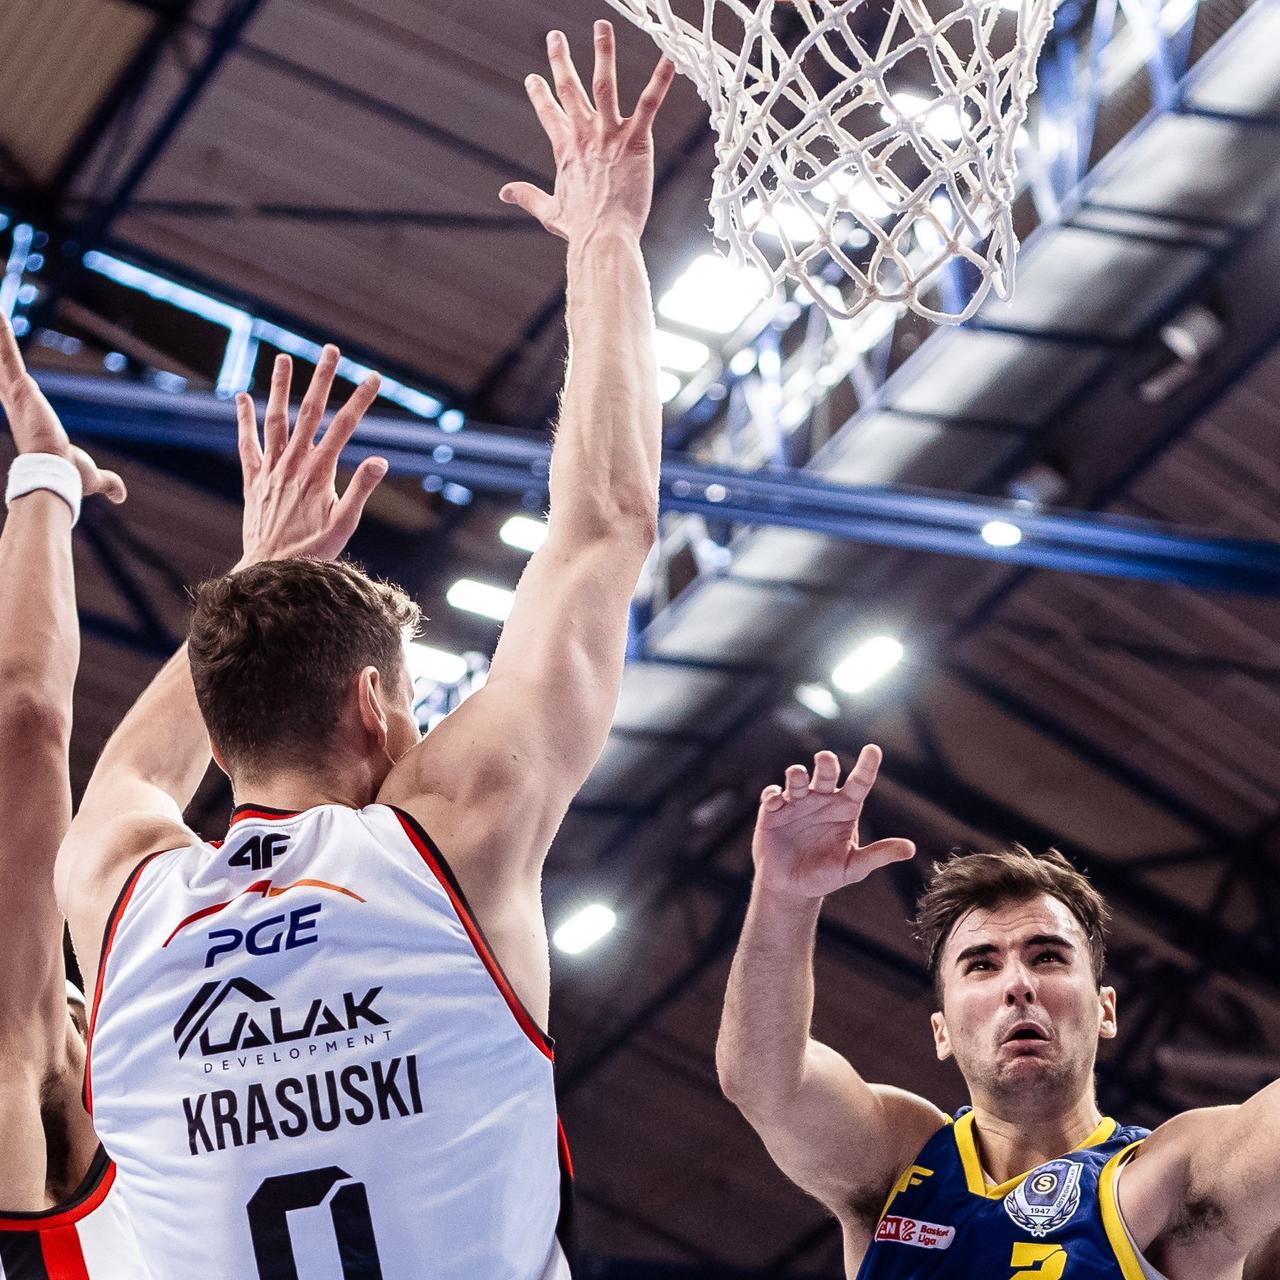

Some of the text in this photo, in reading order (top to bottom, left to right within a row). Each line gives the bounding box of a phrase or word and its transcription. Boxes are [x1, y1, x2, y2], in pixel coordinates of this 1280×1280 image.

[228, 834, 291, 871] 4F
[204, 902, 323, 968] PGE
[204, 1029, 394, 1074] DEVELOPMENT
[181, 1054, 424, 1156] KRASUSKI
[1030, 1207, 1051, 1215] 1947
[918, 1235, 937, 1246] Liga
[920, 1224, 950, 1237] Basket
